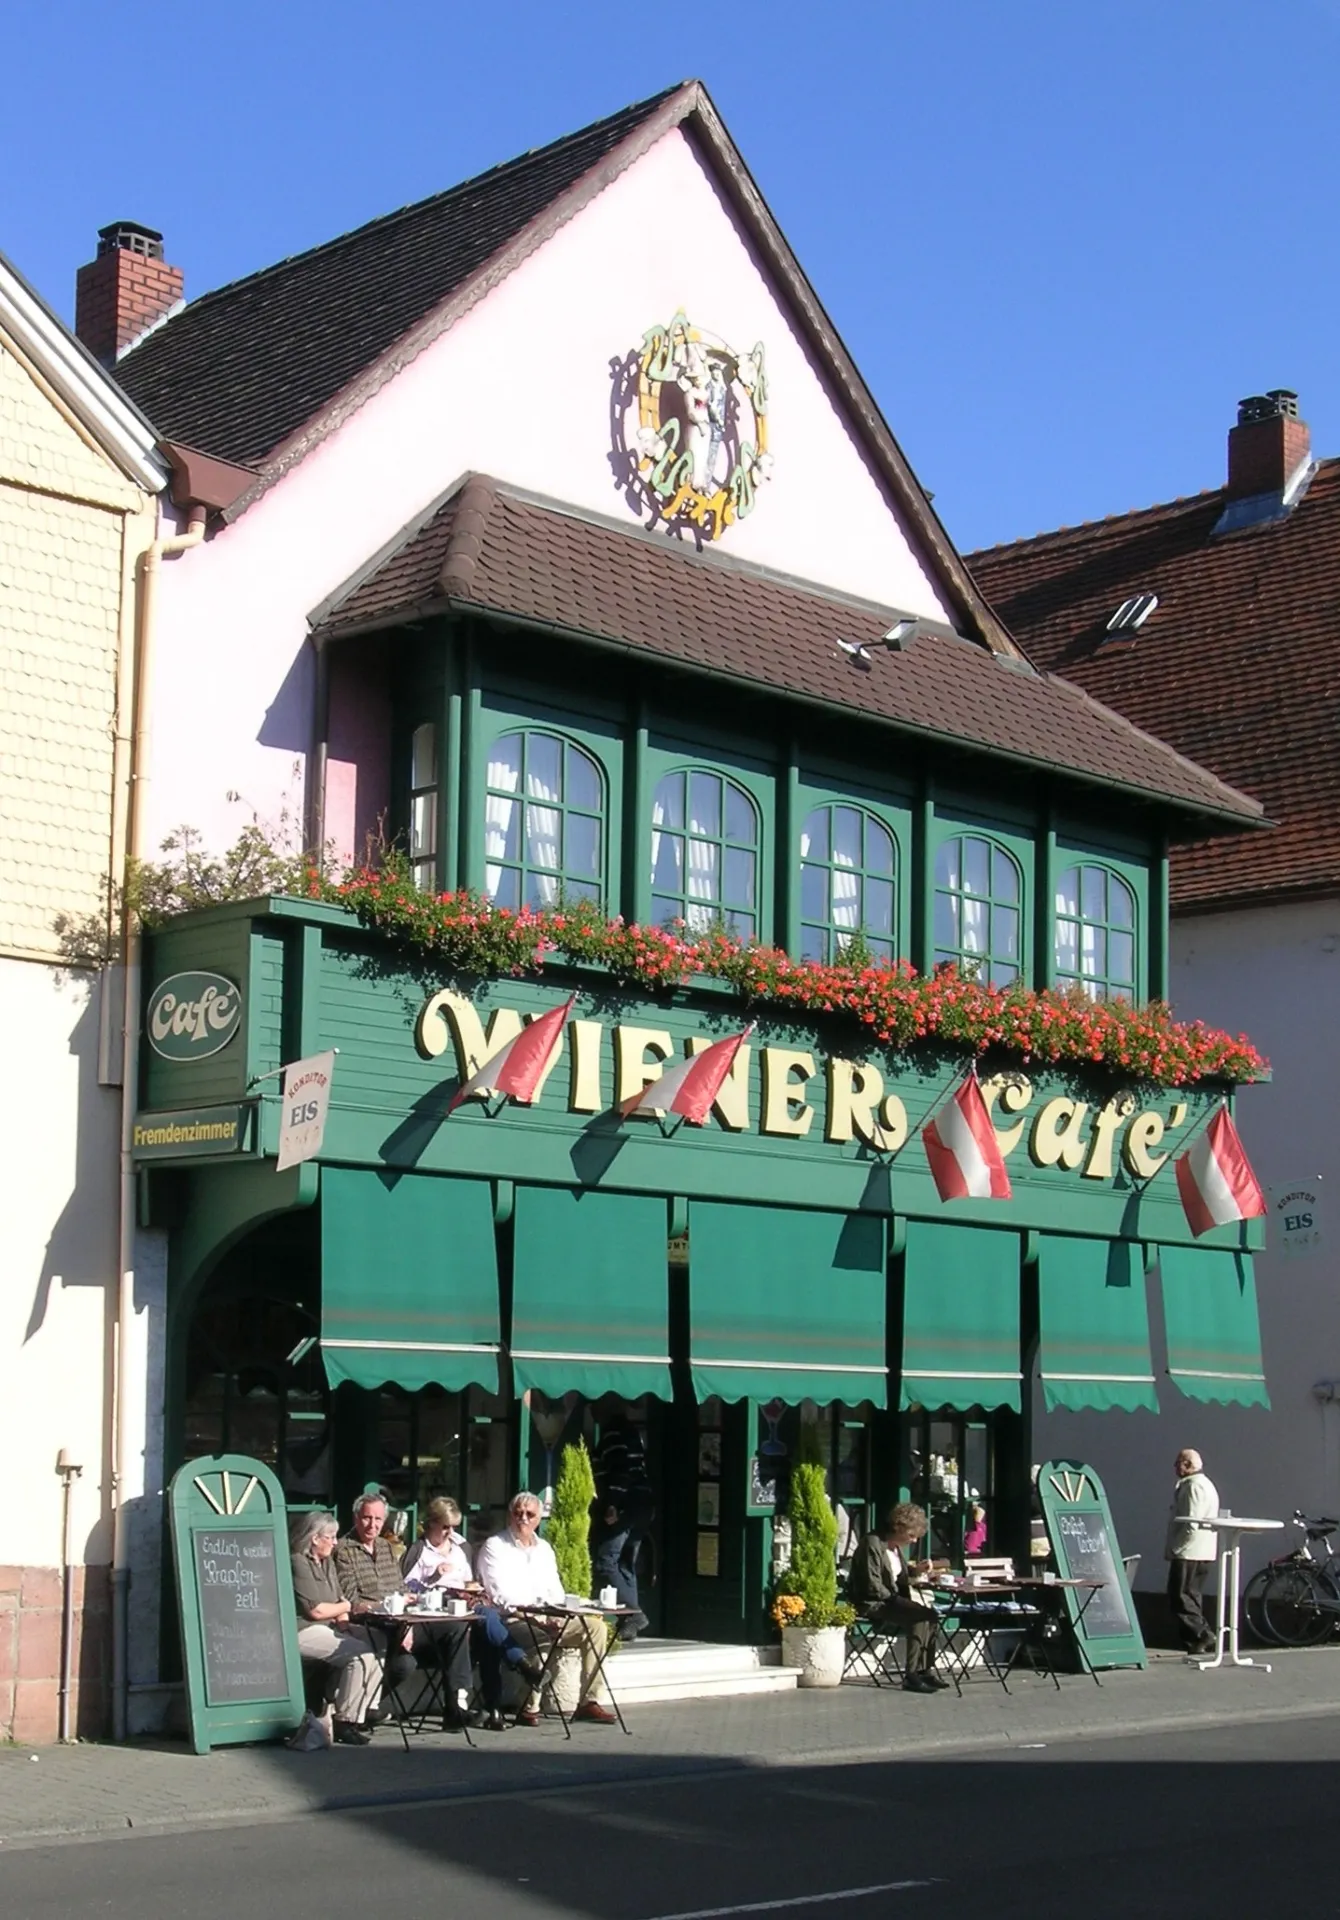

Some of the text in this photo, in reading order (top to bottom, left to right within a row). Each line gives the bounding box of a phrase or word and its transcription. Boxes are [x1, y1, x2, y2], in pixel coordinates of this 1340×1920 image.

[152, 985, 238, 1042] Café
[287, 1072, 328, 1099] KONDITOR
[289, 1100, 319, 1128] EIS
[980, 1072, 1187, 1179] Café
[133, 1120, 238, 1146] Fremdenzimmer
[1277, 1191, 1316, 1210] KONDITOR
[1284, 1213, 1314, 1232] EIS
[202, 1536, 241, 1557] Endlich
[235, 1588, 260, 1609] zeit
